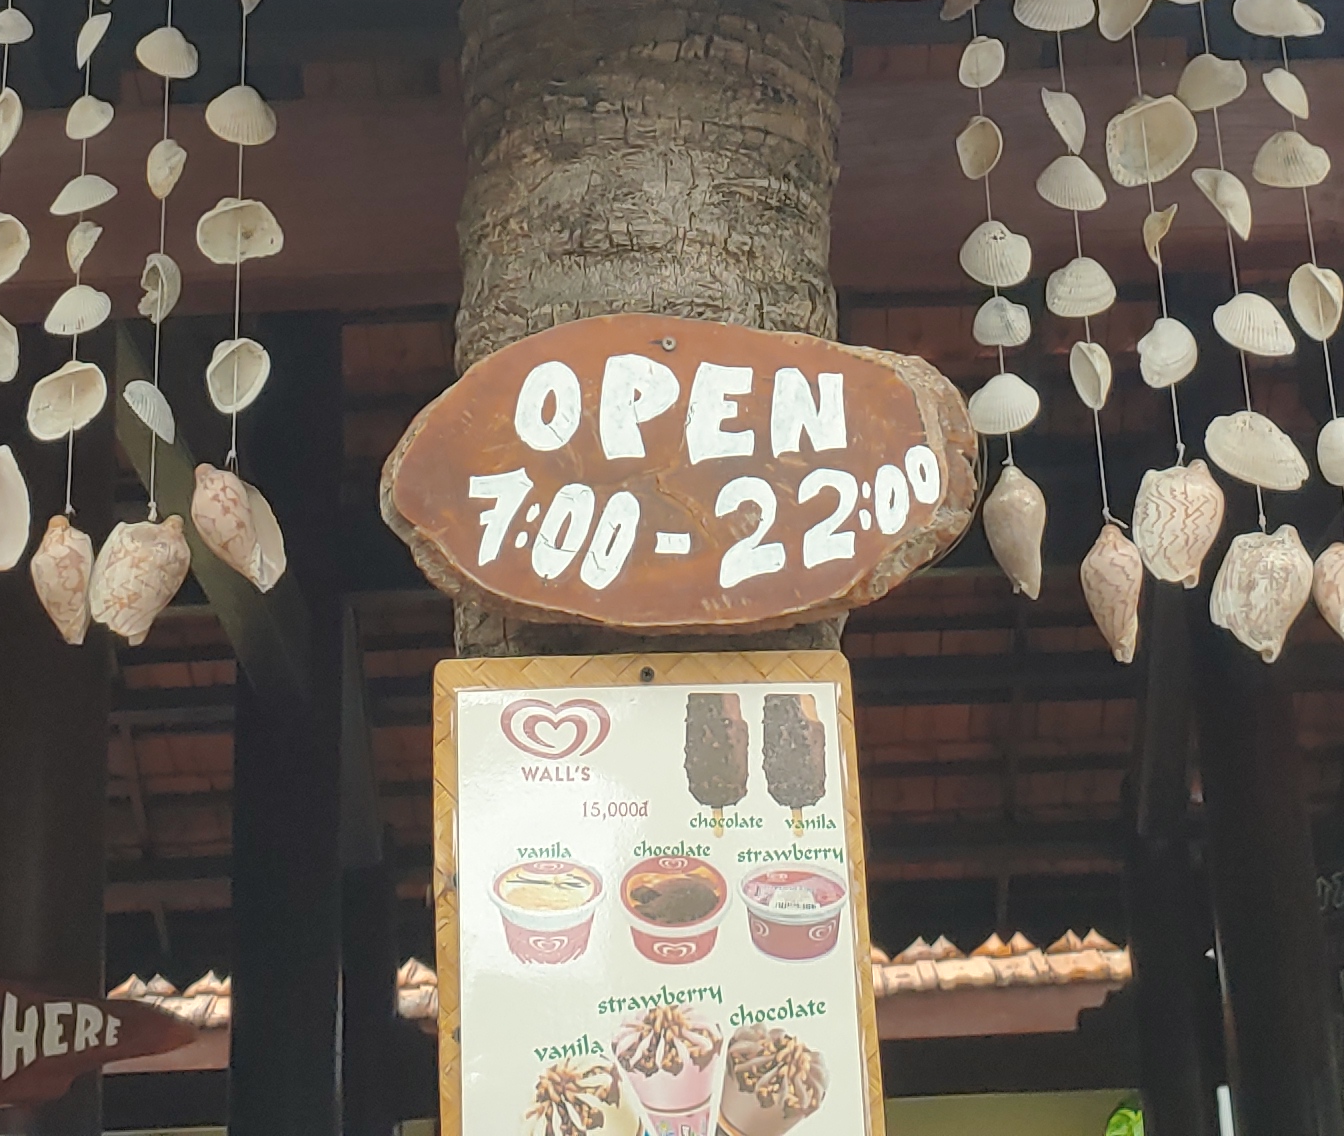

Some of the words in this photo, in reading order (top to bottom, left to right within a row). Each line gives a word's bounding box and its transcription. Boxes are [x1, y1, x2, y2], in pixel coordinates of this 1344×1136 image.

[514, 354, 847, 464] OPEN
[469, 467, 641, 590] 7:00
[715, 445, 940, 588] 22:00
[521, 766, 591, 782] WALL'S
[689, 812, 763, 829] chocolate
[785, 814, 837, 829] vanila
[516, 842, 572, 858] vanila
[633, 840, 711, 857] chocolate
[737, 842, 844, 863] strawberry
[597, 985, 723, 1014] strawberry
[729, 998, 827, 1026] chocolate
[1, 991, 121, 1079] HERE
[534, 1034, 604, 1062] vanila
